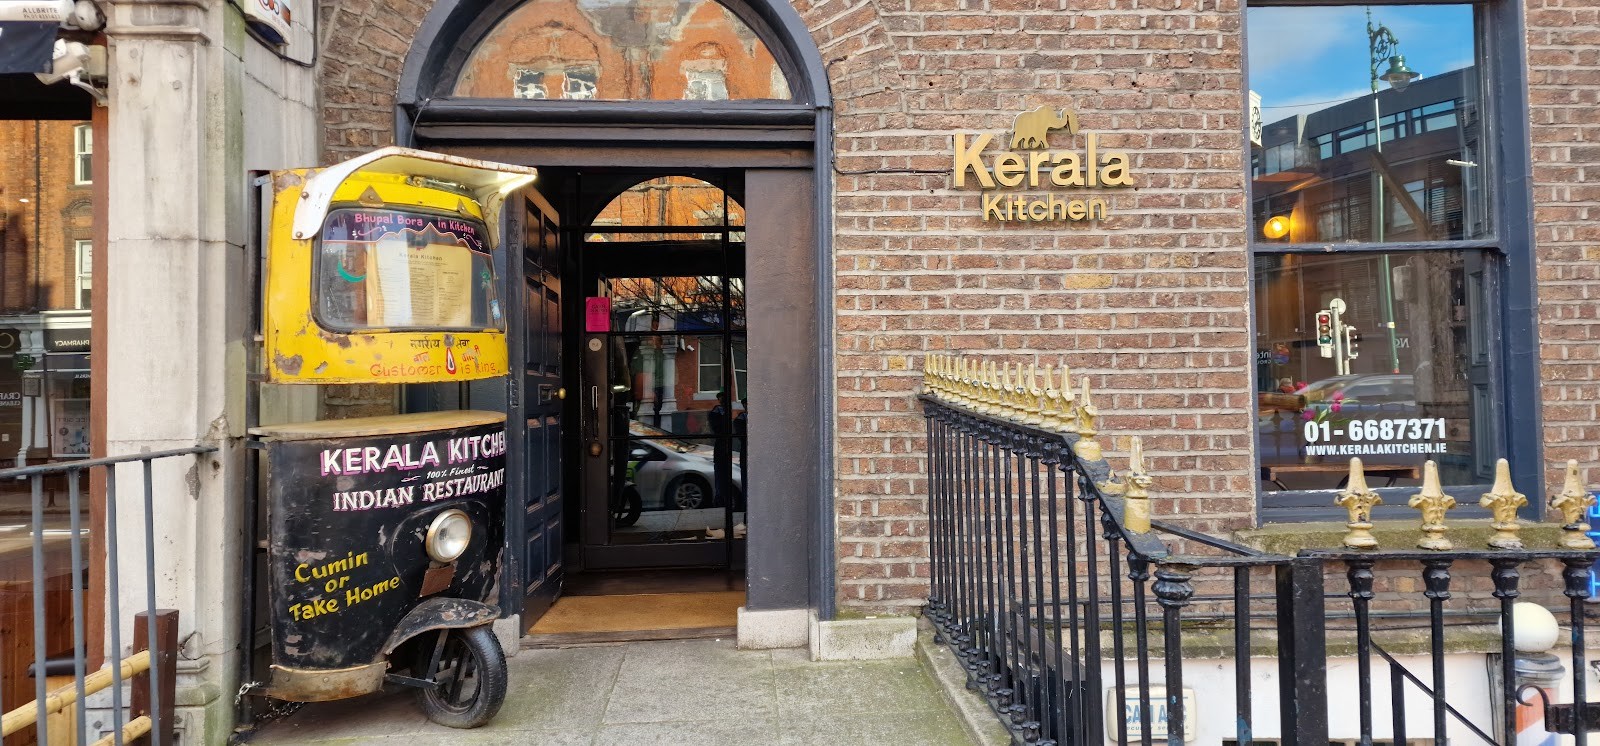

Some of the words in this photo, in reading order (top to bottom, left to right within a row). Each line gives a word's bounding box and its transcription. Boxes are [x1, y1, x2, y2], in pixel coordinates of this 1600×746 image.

[953, 132, 1134, 188] Kerala
[981, 192, 1108, 222] Kitchen
[354, 213, 393, 226] Bhupal
[397, 214, 423, 226] Bora
[437, 218, 447, 229] in
[450, 220, 475, 235] Kitchen
[370, 362, 442, 377] Customer
[459, 363, 470, 375] is
[1348, 417, 1446, 441] 6687371
[320, 441, 440, 477] KERALA
[1305, 442, 1447, 456] WWW.KERALAKITCHEN.IE
[426, 469, 447, 480] 100%
[449, 463, 475, 477] Finest
[332, 485, 415, 512] INDIAN
[421, 467, 505, 503] RESTAURANT
[294, 550, 369, 583] Cumin
[324, 575, 350, 593] or
[288, 597, 339, 622] Take
[345, 575, 400, 608] Home
